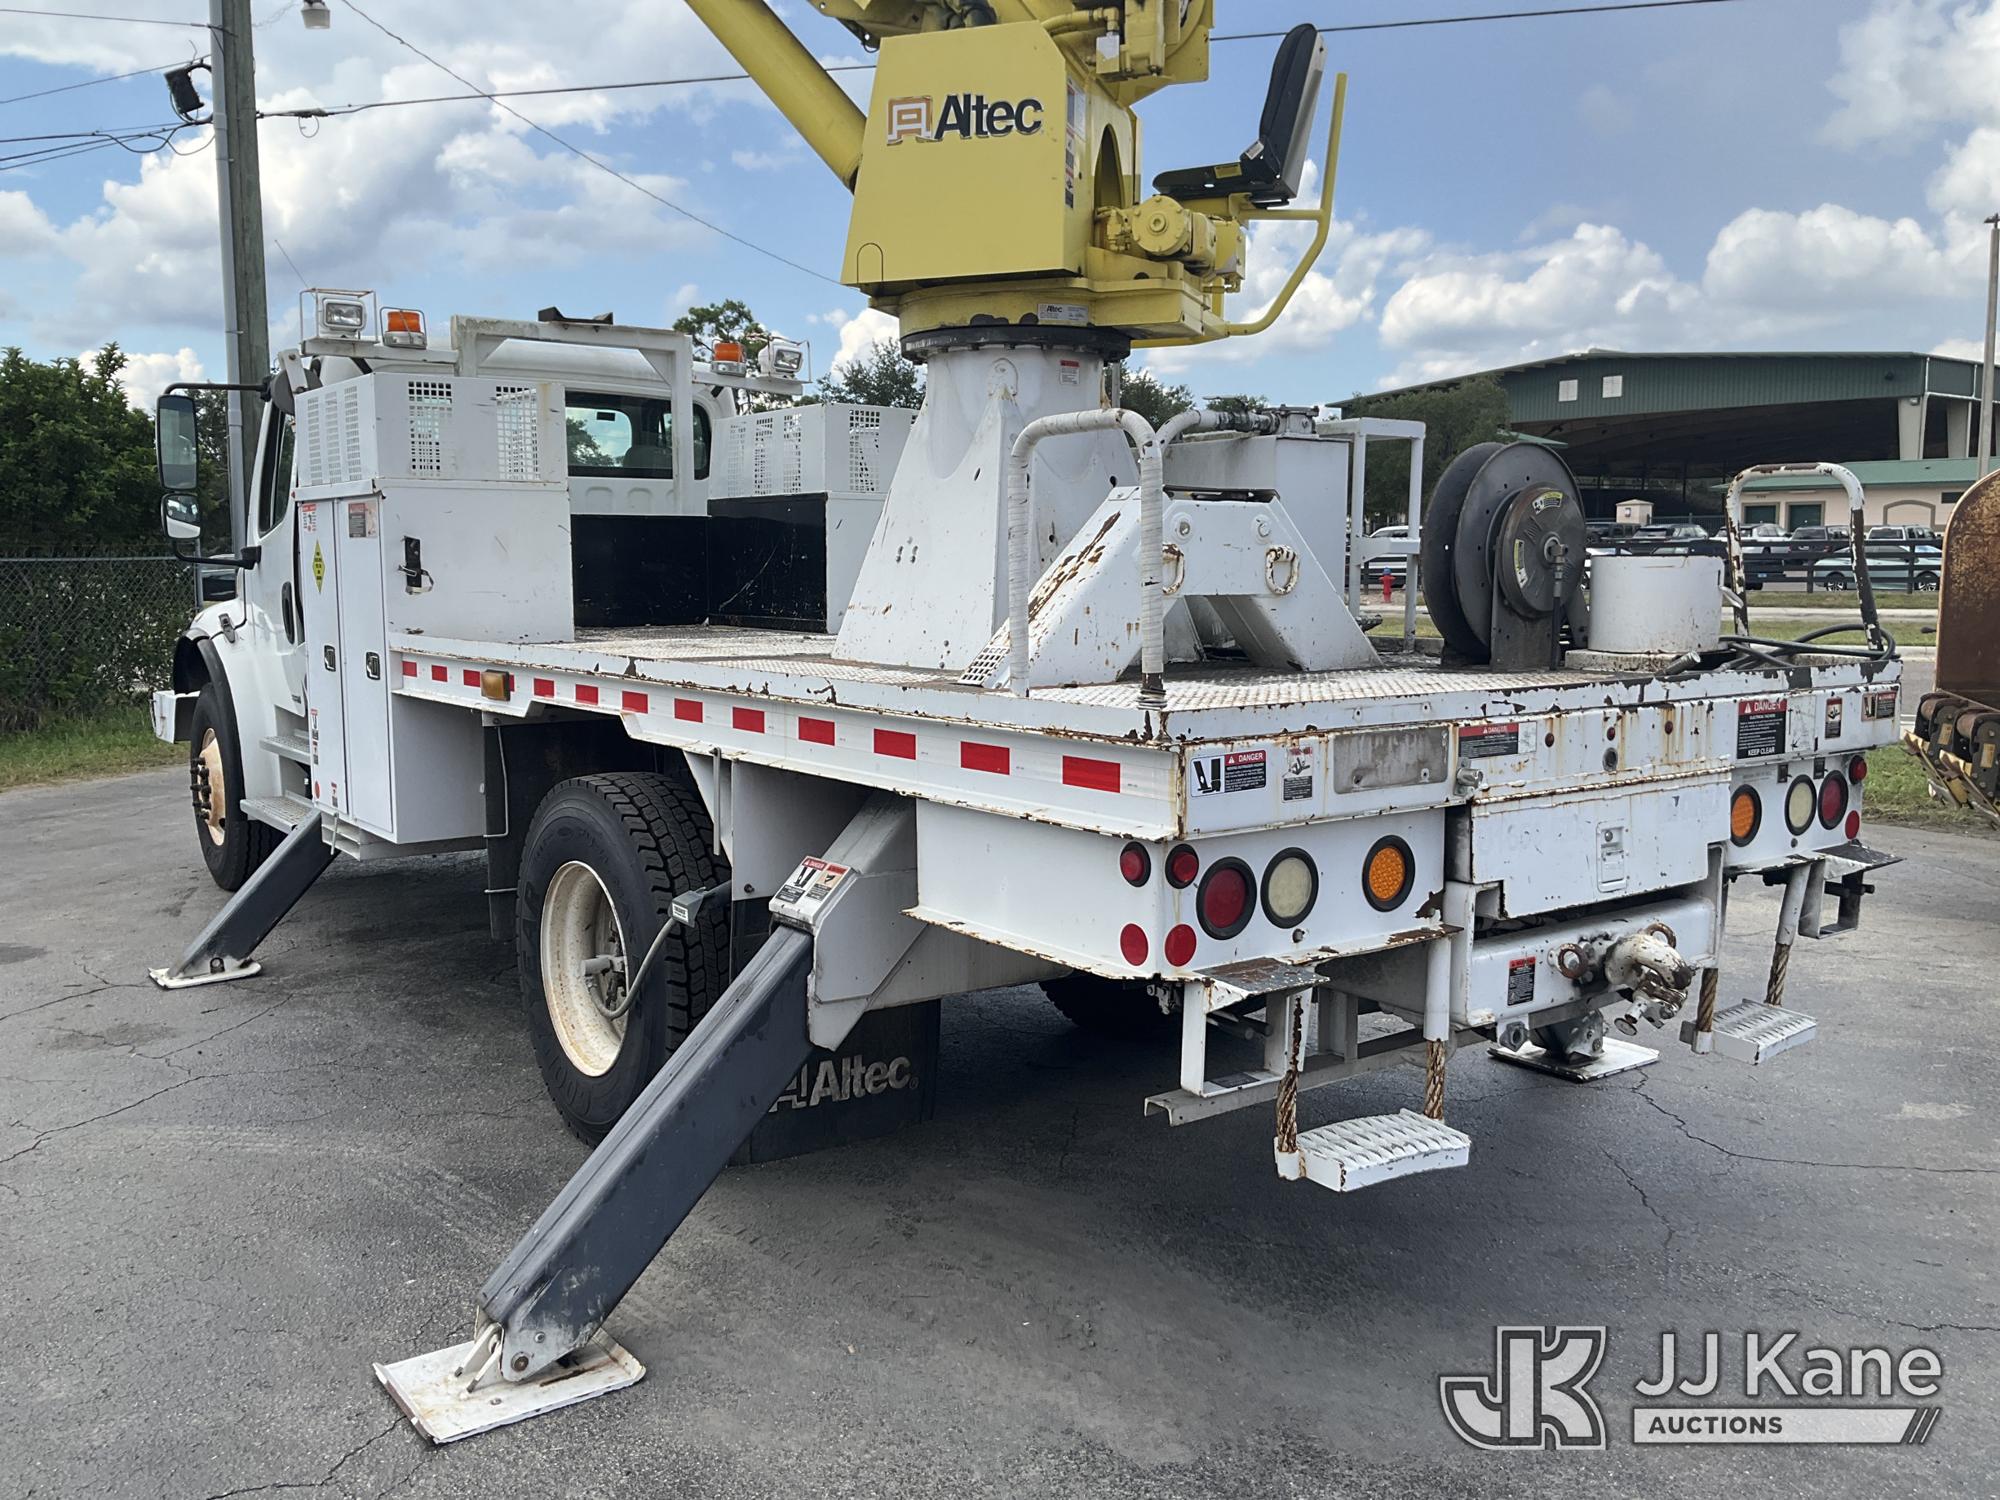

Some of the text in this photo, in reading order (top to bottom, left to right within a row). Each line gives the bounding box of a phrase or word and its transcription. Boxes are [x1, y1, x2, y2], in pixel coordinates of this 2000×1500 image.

[934, 93, 1043, 141] Altec
[1238, 752, 1263, 763] DANGER
[809, 1055, 912, 1106] Altec
